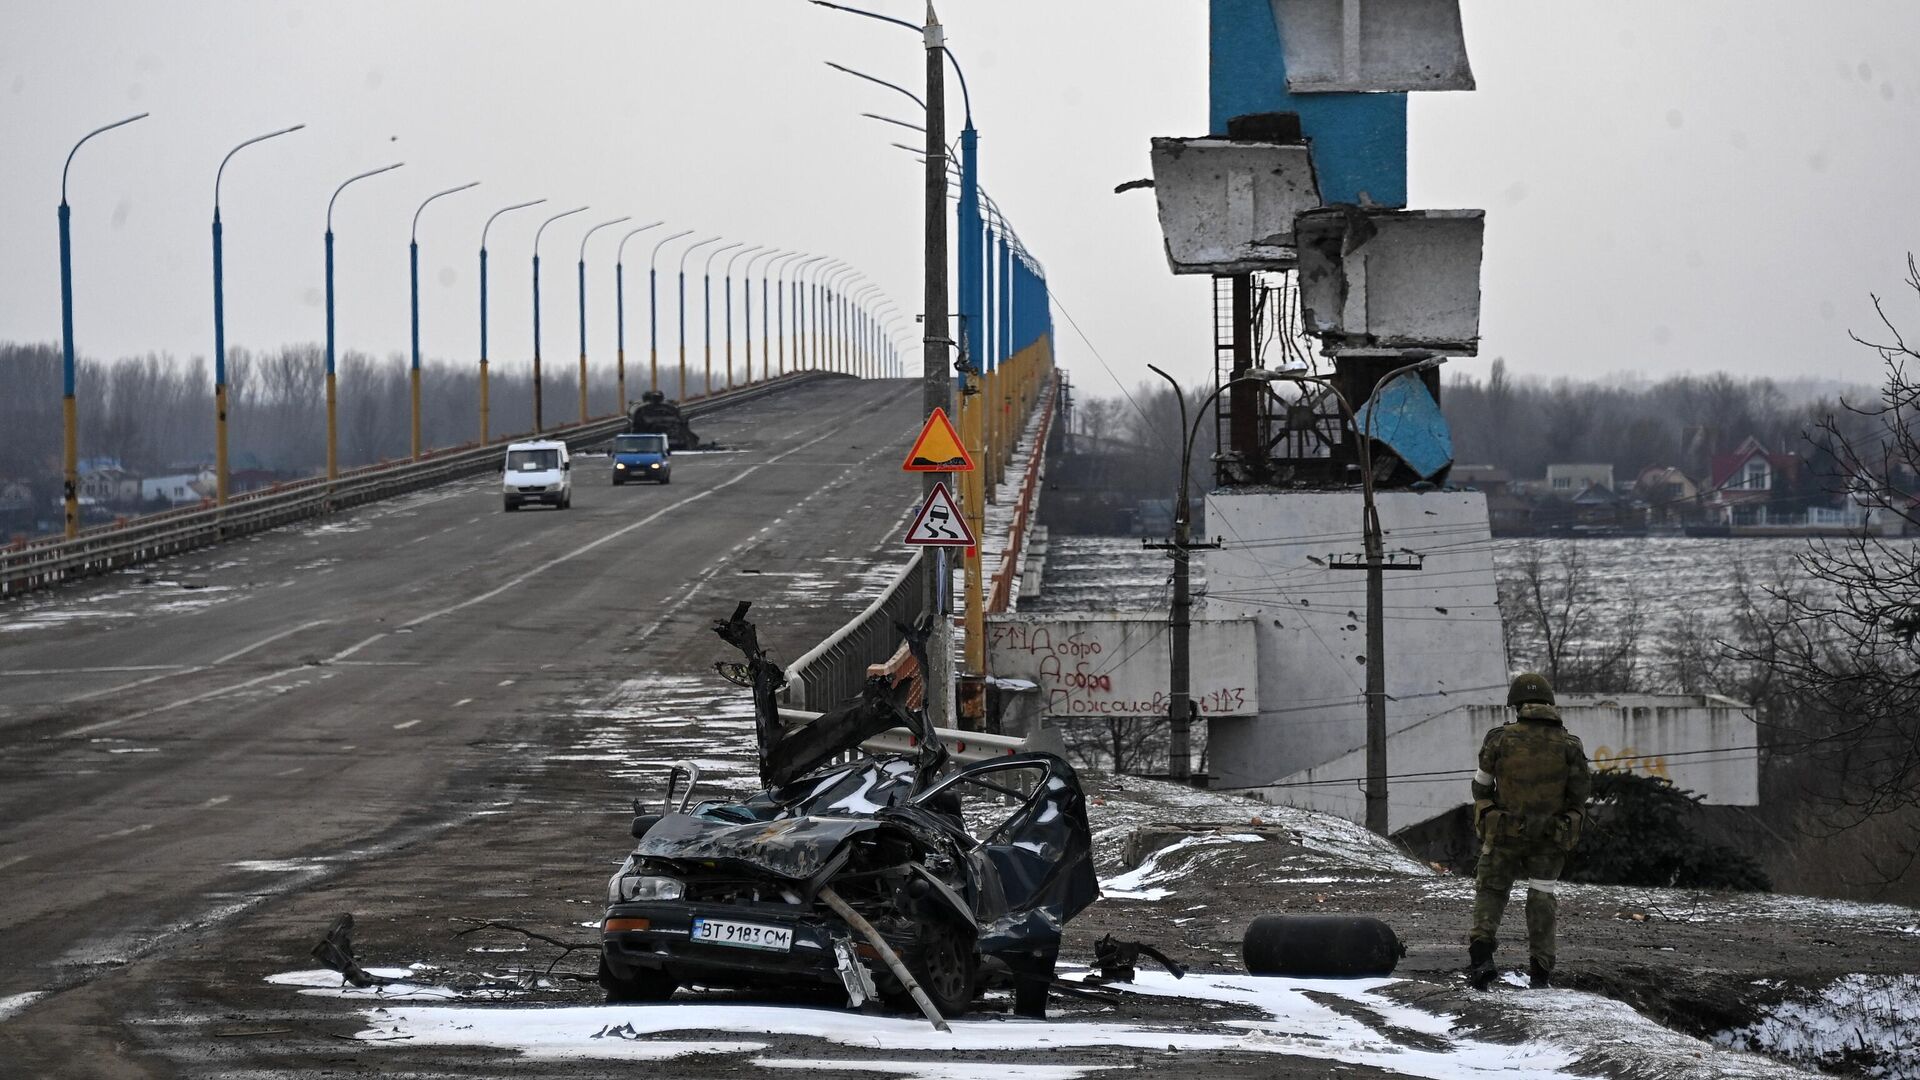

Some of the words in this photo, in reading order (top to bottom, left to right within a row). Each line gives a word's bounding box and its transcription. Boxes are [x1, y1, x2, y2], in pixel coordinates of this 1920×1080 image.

[701, 922, 723, 939] BT
[726, 925, 761, 943] 9183
[764, 930, 787, 946] CM
